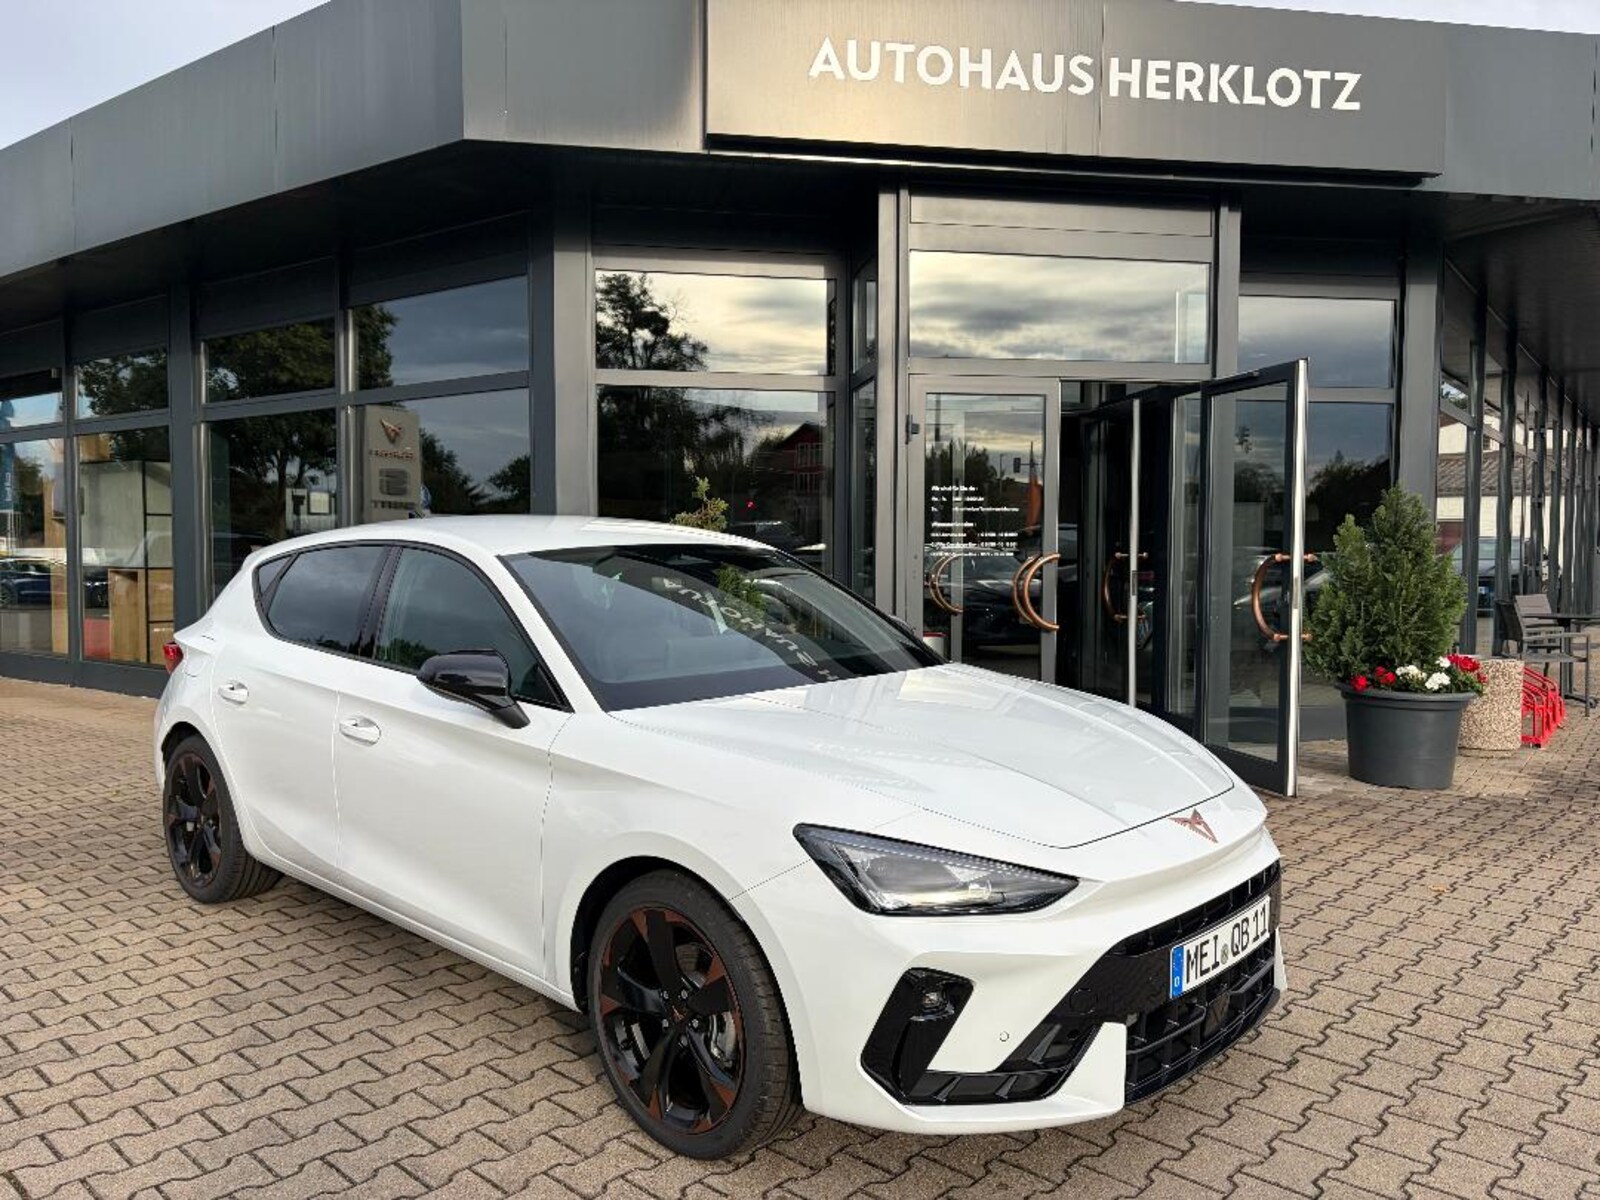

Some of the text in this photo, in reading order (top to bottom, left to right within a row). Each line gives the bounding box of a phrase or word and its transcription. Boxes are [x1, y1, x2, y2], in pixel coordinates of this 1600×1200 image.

[808, 37, 1363, 111] AUTOHAUS HERKLOTZ
[1186, 903, 1267, 984] MEI QB 11
